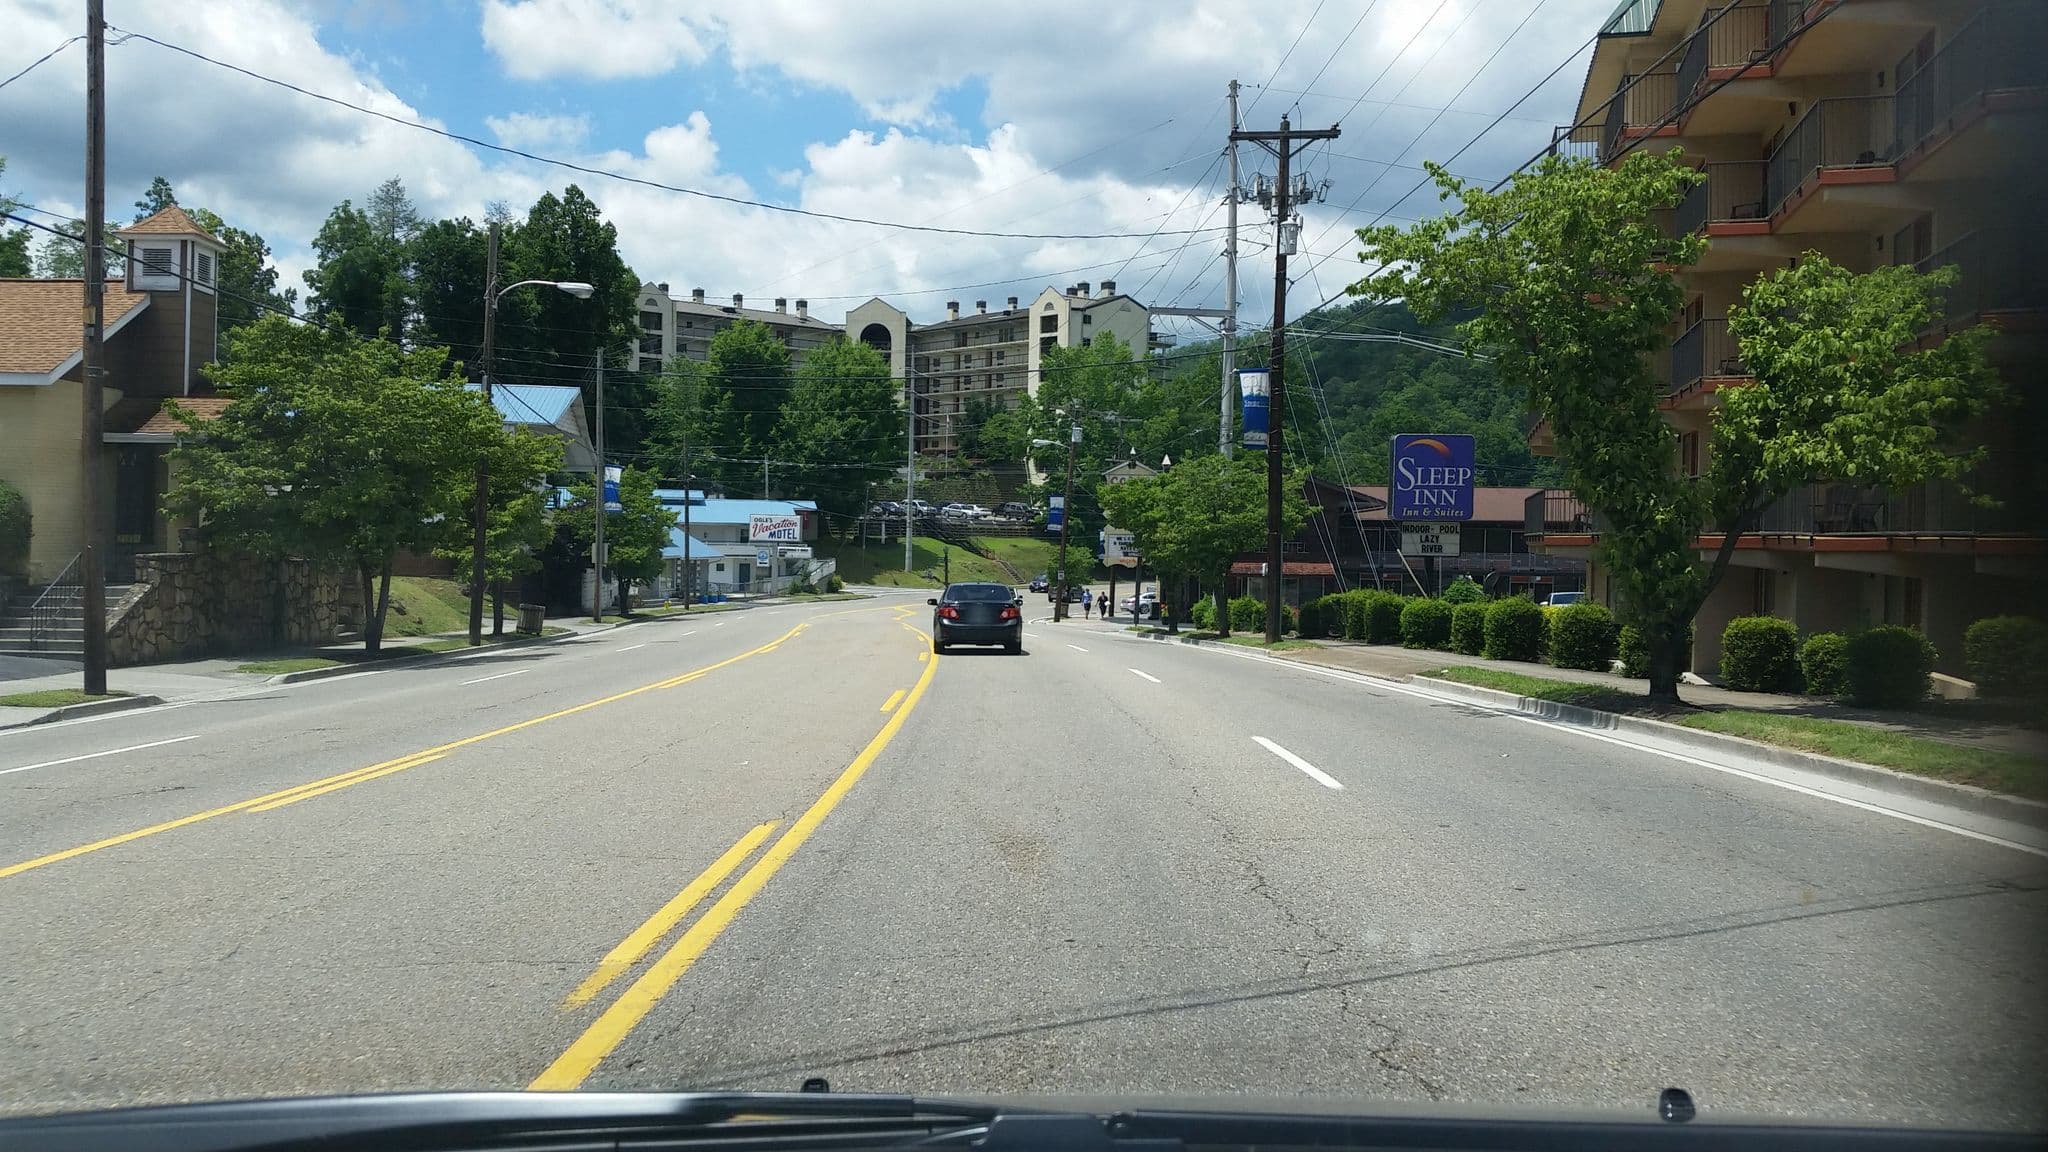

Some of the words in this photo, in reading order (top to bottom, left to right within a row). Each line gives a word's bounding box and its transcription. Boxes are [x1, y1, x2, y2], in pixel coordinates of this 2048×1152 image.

[1397, 457, 1471, 491] SLEEP
[1413, 488, 1457, 506] INN
[1402, 507, 1419, 516] Inn
[1422, 507, 1432, 516] &
[1433, 507, 1464, 516] Suites
[752, 518, 798, 538] Vacation
[1439, 525, 1460, 534] POOL
[768, 528, 797, 540] MOTEL
[1419, 534, 1440, 543] LAZY
[1421, 544, 1443, 554] RIVER
